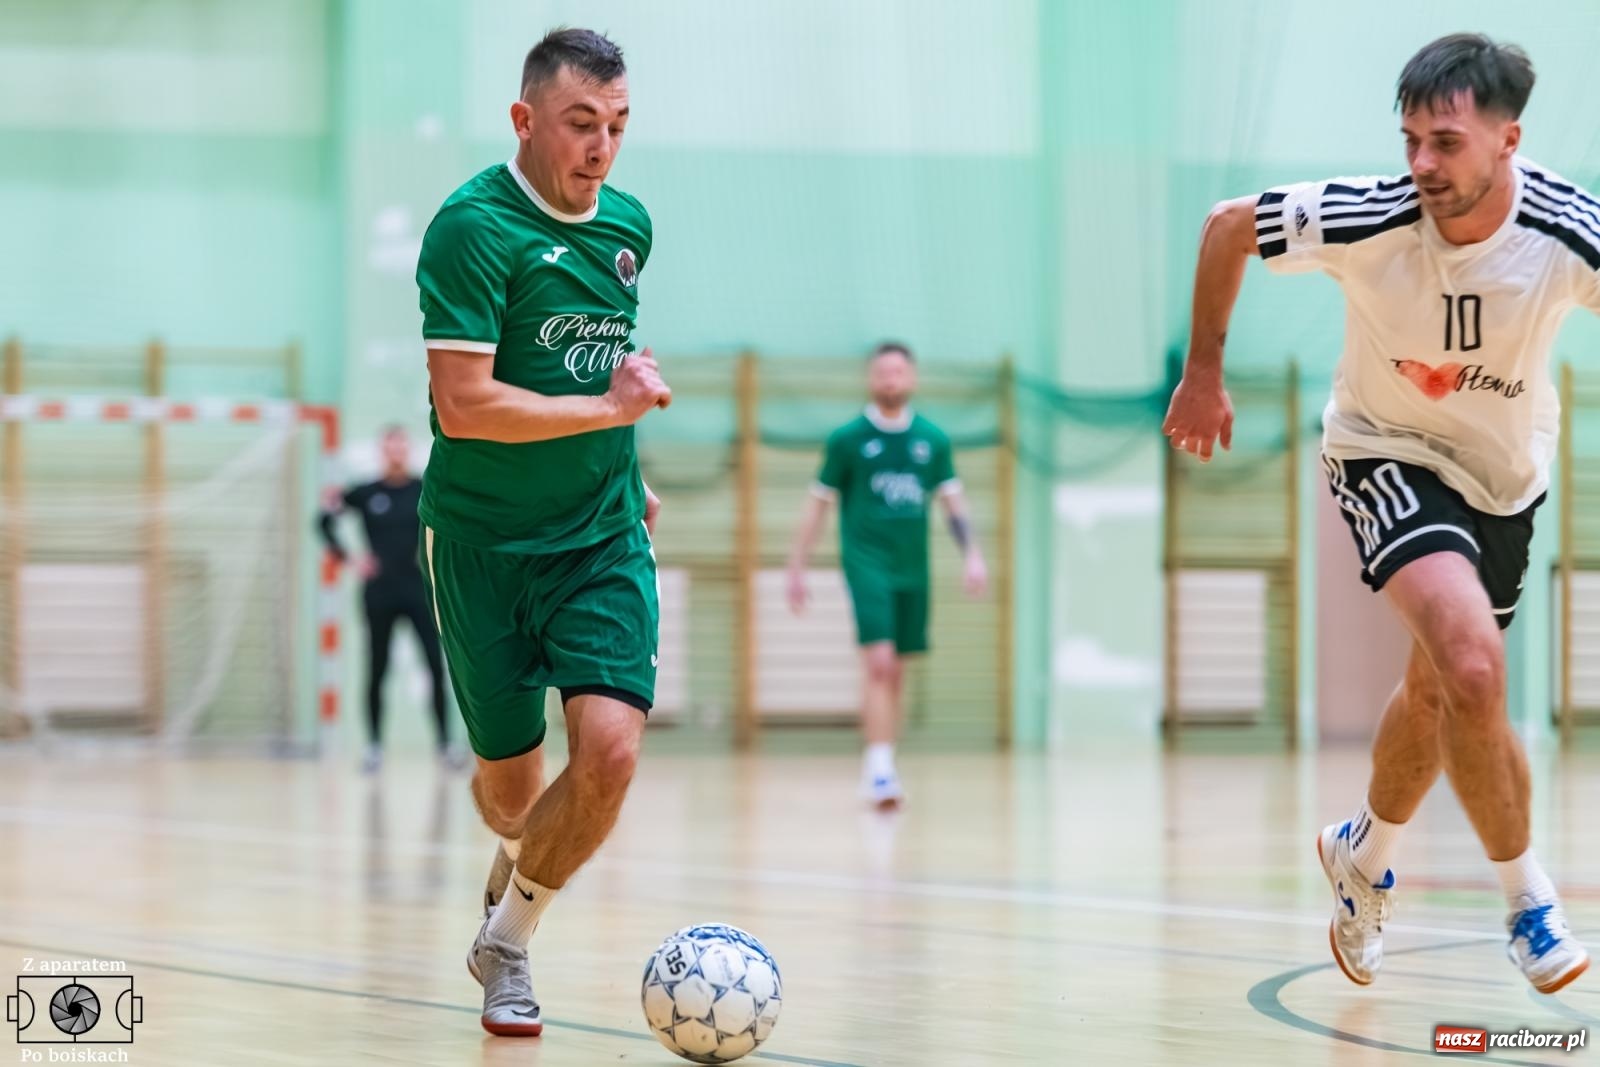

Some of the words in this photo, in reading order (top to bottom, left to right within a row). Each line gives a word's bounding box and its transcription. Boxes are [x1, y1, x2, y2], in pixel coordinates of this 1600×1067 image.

[535, 311, 629, 350] Piękne
[1441, 293, 1481, 351] 10
[1358, 461, 1420, 531] 10
